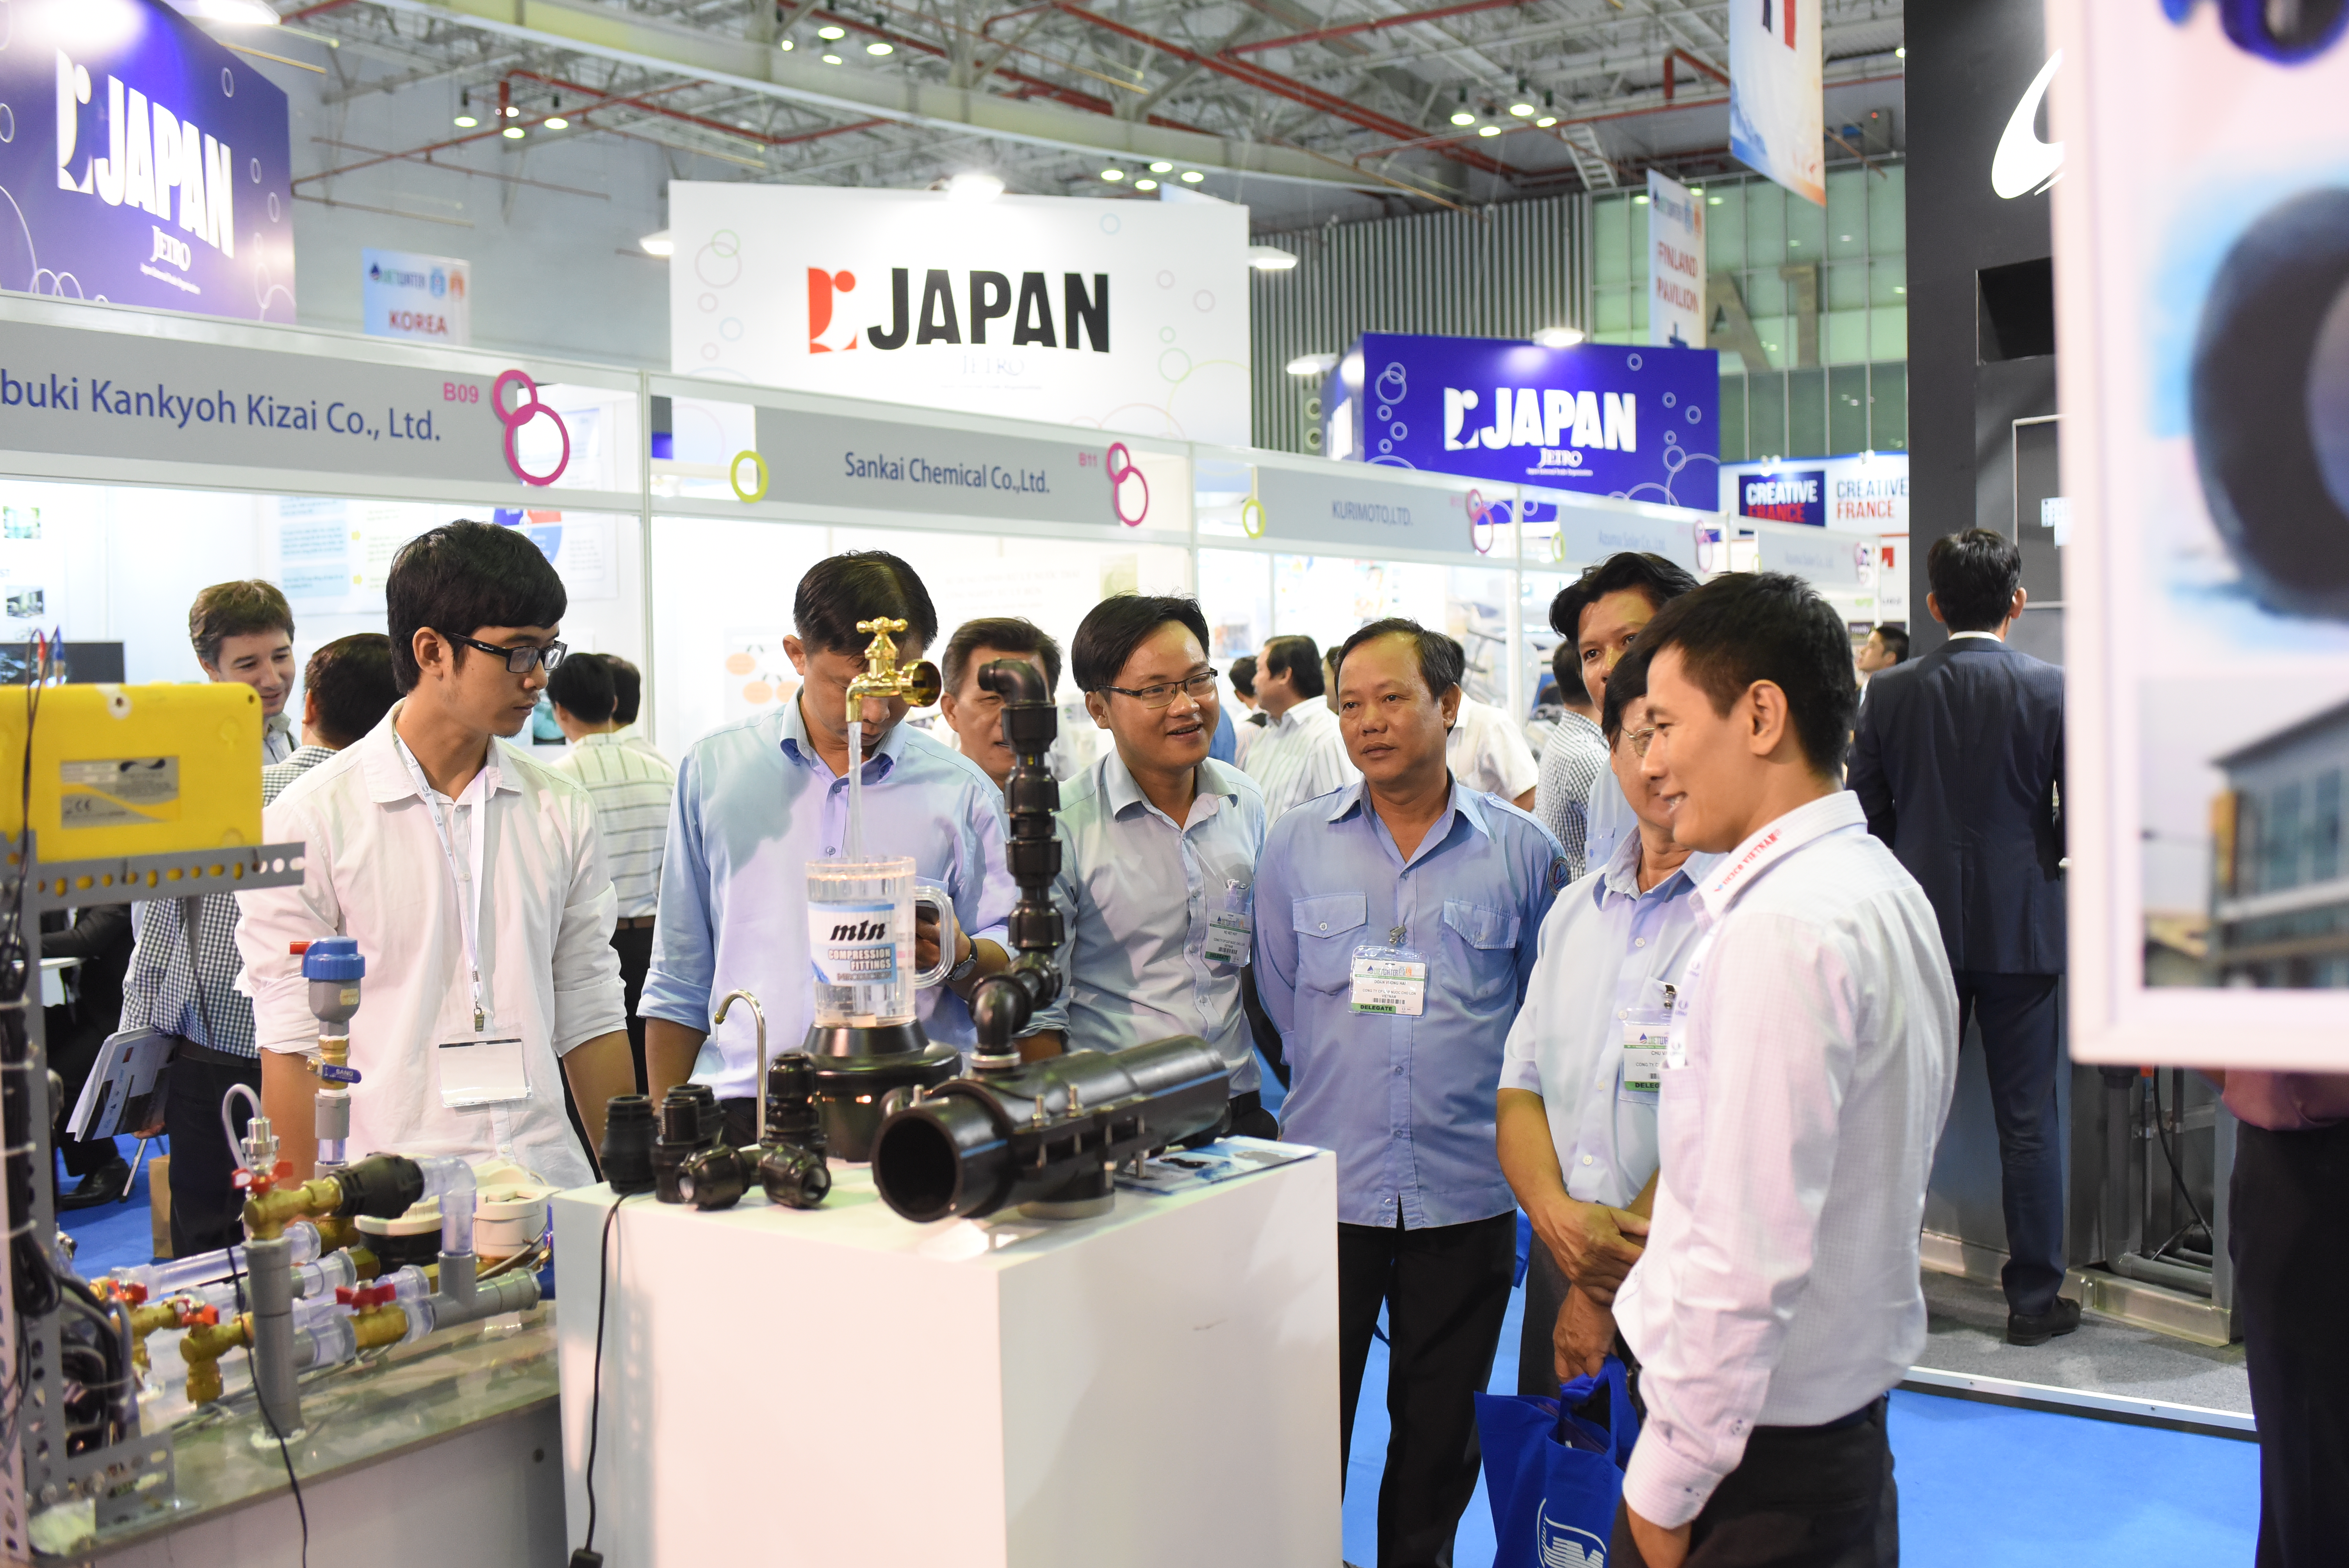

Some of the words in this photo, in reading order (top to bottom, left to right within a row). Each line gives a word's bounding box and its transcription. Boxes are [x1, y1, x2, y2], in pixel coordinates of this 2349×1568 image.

[94, 74, 234, 259] JAPAN
[1658, 240, 1698, 278] FINLAND
[1656, 276, 1698, 314] PAVILION
[389, 310, 448, 336] KOREA
[867, 267, 1109, 353] JAPAN
[1, 369, 78, 410] buki
[91, 378, 235, 428] Kankyoh
[248, 394, 317, 430] Kizai
[327, 402, 380, 440] Co.,
[389, 408, 441, 441] Ltd.
[443, 382, 479, 403] B09
[1480, 388, 1636, 453] JAPAN
[845, 451, 904, 480] Sankai
[909, 458, 986, 487] Chemical
[1745, 480, 1818, 506] CREATIVE
[1837, 478, 1908, 498] CREATIVE
[1748, 502, 1805, 522] FRANCE
[1837, 499, 1894, 519] FRANCE
[828, 947, 891, 960] COMPRESSION
[850, 959, 891, 971] FITTINGS
